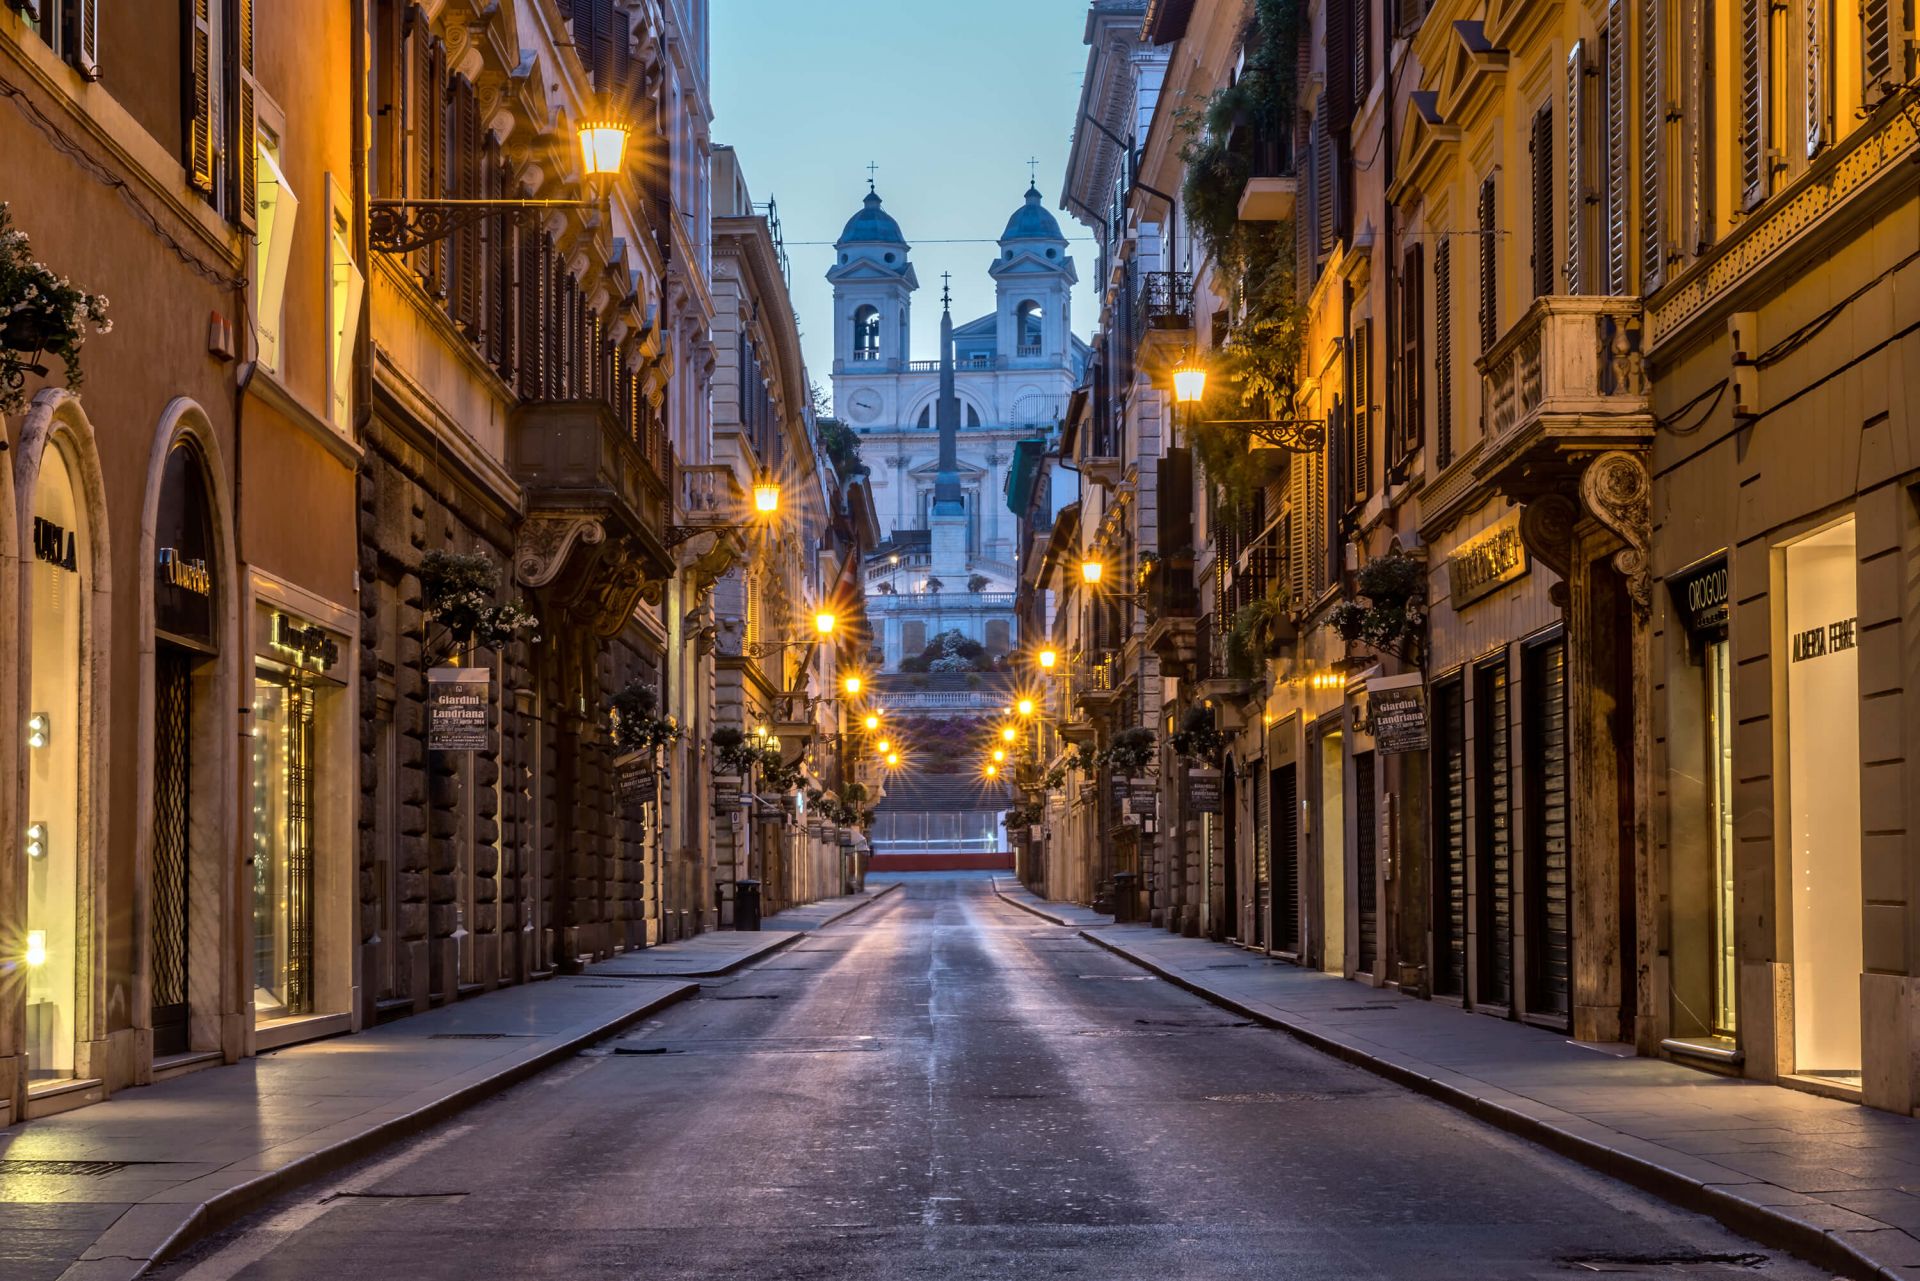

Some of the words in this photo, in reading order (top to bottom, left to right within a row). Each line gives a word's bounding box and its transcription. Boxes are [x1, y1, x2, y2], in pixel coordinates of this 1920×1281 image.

[1689, 569, 1728, 612] OROGOLD
[438, 696, 479, 704] Giardini
[1380, 699, 1417, 712] Giardini
[433, 710, 484, 718] Landriana
[1377, 712, 1423, 725] Landriana
